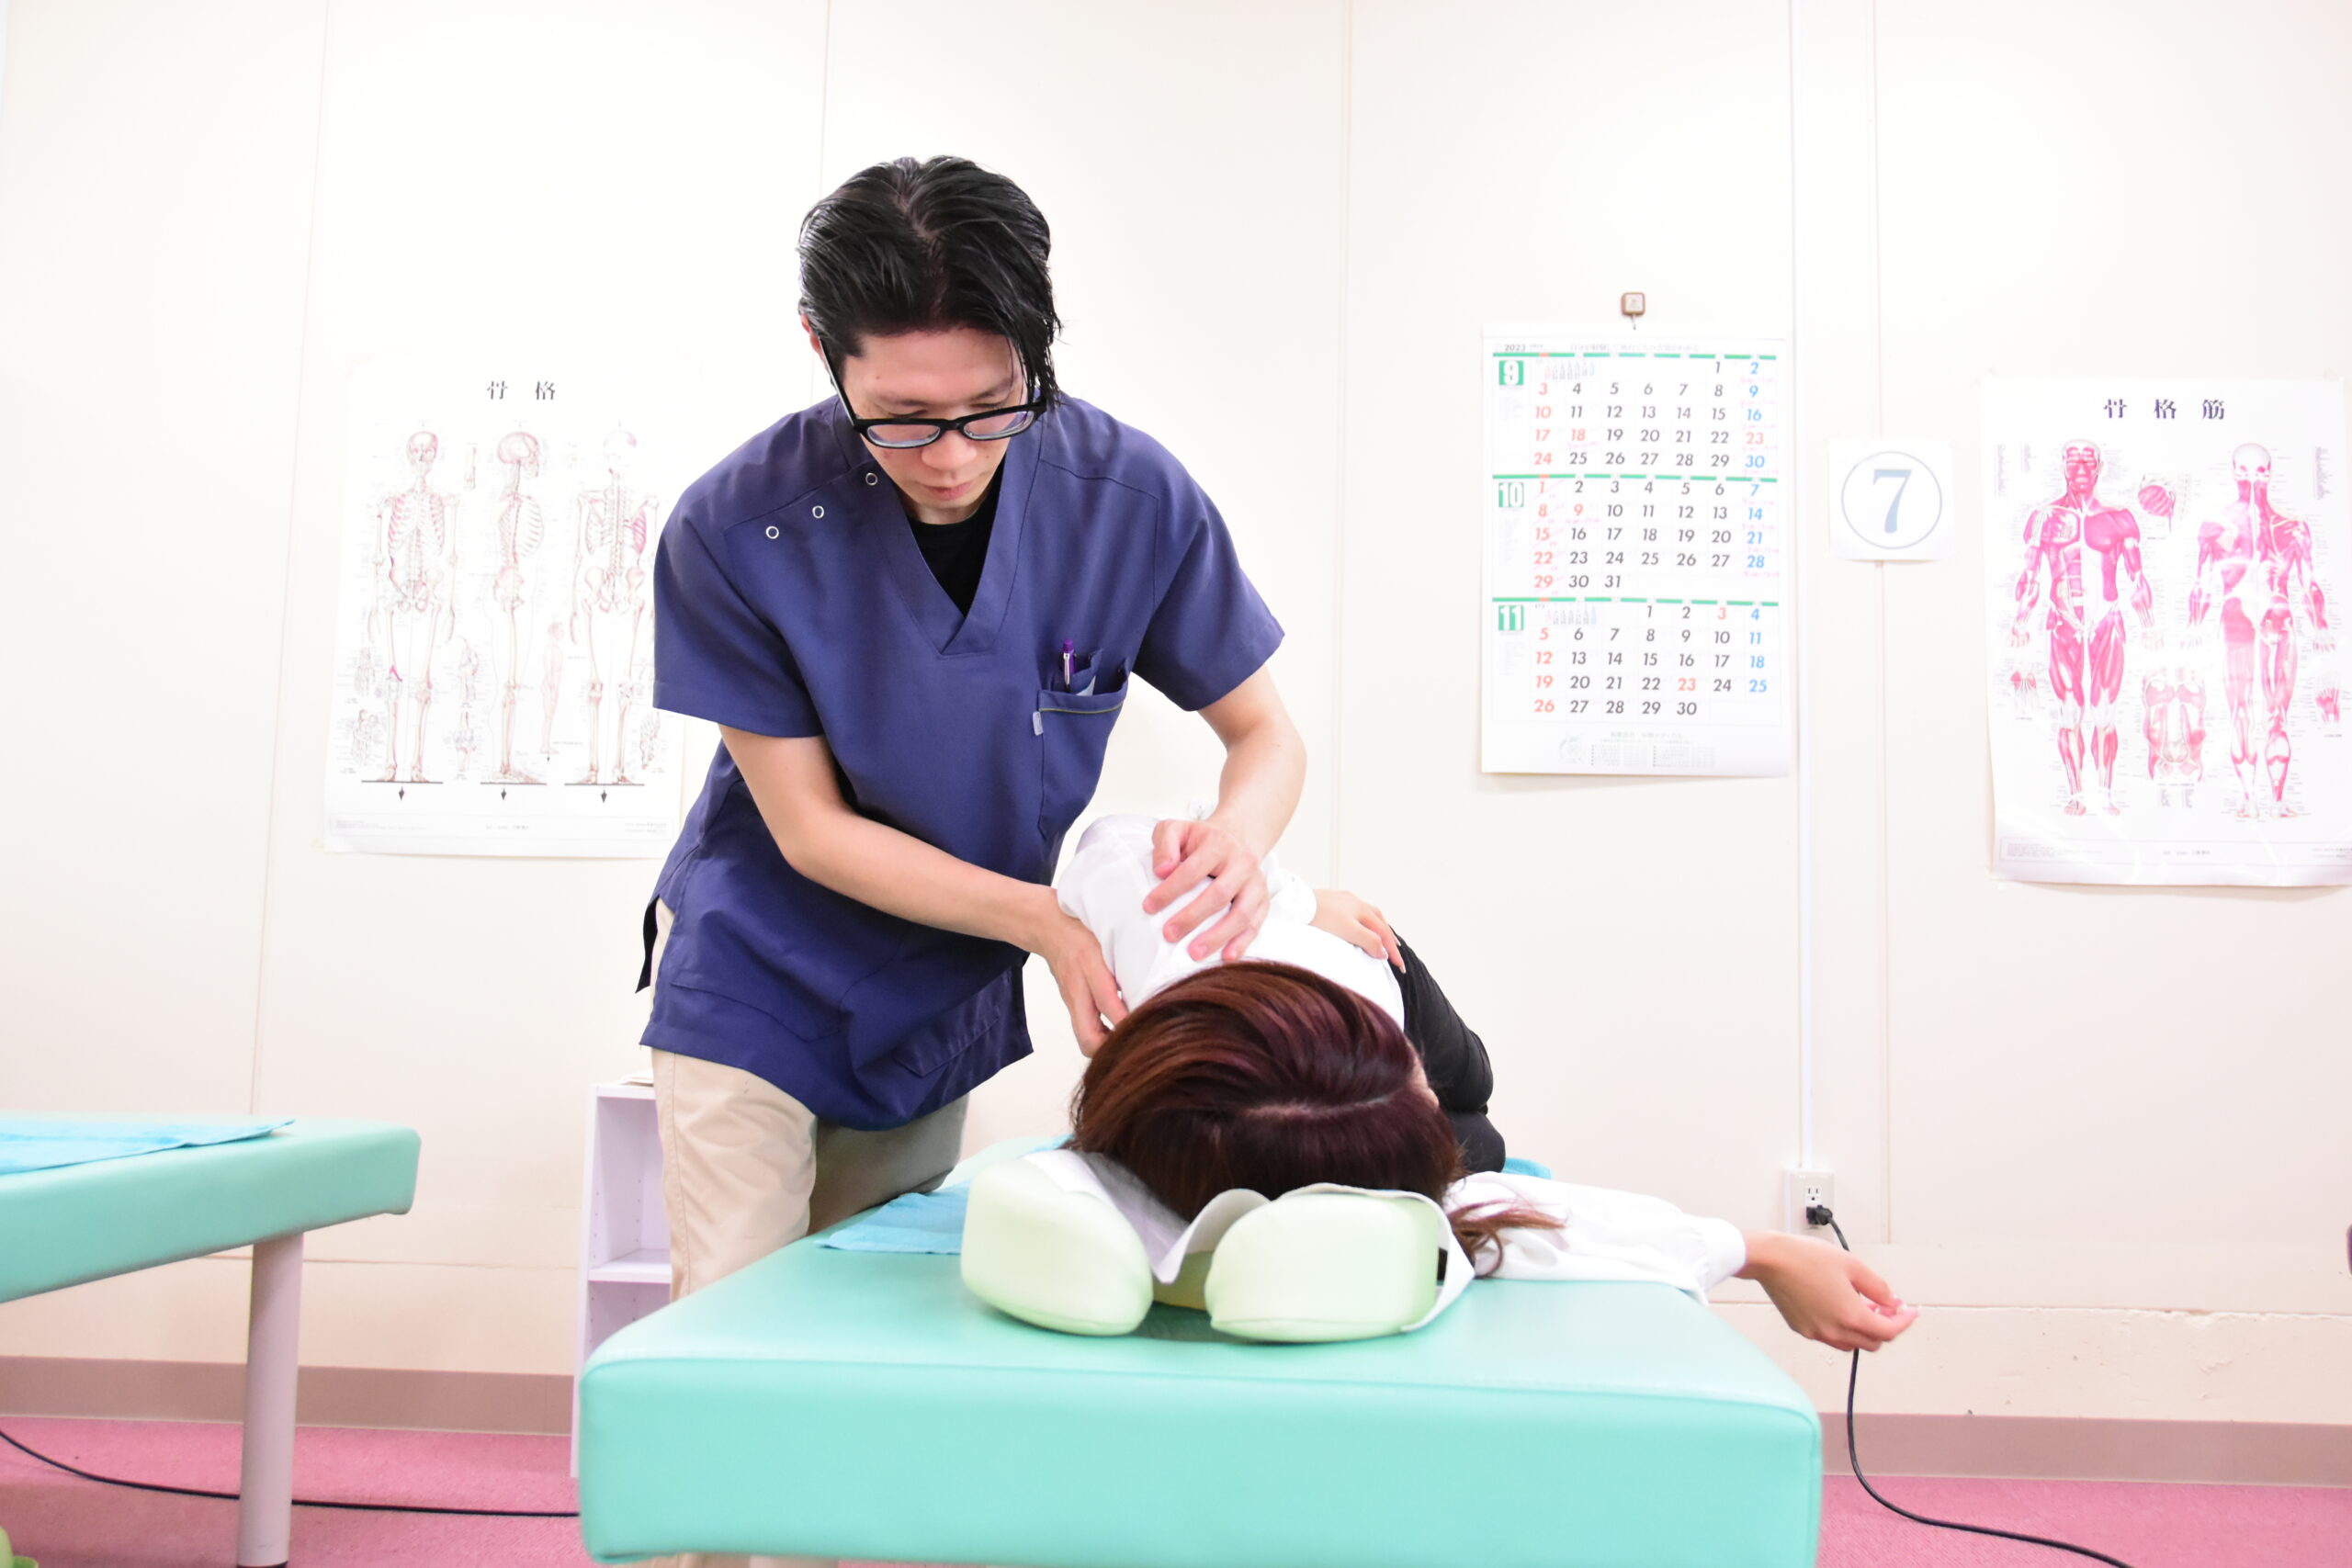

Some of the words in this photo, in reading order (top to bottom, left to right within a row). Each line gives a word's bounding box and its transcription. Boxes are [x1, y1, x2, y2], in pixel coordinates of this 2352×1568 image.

[1502, 360, 1521, 385] 9
[1715, 361, 1721, 374] 1
[1750, 361, 1760, 375] 2
[486, 380, 556, 400] 骨格
[1539, 382, 1548, 396] 3
[1572, 382, 1582, 395] 4
[1610, 382, 1619, 395] 5
[1644, 383, 1654, 396] 6
[1679, 383, 1689, 396] 7
[1713, 384, 1724, 398] 8
[1748, 385, 1759, 398] 9
[1535, 405, 1552, 419] 10
[1570, 405, 1583, 419] 11
[1607, 404, 1623, 419] 12
[1642, 405, 1657, 419] 13
[1677, 406, 1691, 420] 14
[1712, 407, 1726, 421] 15
[1747, 408, 1763, 422] 16
[2103, 399, 2224, 420] 骨格筋
[1535, 428, 1551, 442] 17
[1571, 428, 1586, 442] 18
[1607, 428, 1624, 442] 19
[1640, 428, 1660, 443] 20
[1675, 429, 1691, 444] 21
[1711, 430, 1729, 445] 22
[1747, 432, 1764, 445] 23
[1533, 452, 1553, 466] 24
[1569, 451, 1588, 465] 25
[1605, 451, 1625, 465] 26
[1640, 452, 1659, 466] 27
[1676, 453, 1694, 467] 28
[1711, 454, 1730, 468] 29
[1745, 455, 1766, 468] 30
[1499, 482, 1522, 507] 10
[1540, 480, 1545, 494] 1
[1574, 479, 1584, 493] 2
[1610, 479, 1620, 494] 3
[1644, 480, 1654, 494] 4
[1680, 481, 1690, 495] 5
[1714, 482, 1725, 496] 6
[1750, 483, 1760, 497] 7
[1872, 468, 1913, 534] 7
[1538, 503, 1548, 518] 8
[1573, 503, 1584, 516] 9
[1607, 503, 1623, 518] 10
[1642, 504, 1655, 518] 11
[1679, 505, 1694, 519] 12
[1713, 506, 1728, 520] 13
[1748, 506, 1763, 521] 14
[1535, 527, 1551, 541] 15
[1571, 527, 1587, 541] 16
[1607, 527, 1623, 541] 17
[1643, 527, 1658, 542] 18
[1678, 528, 1695, 543] 19
[1712, 529, 1732, 544] 20
[1747, 530, 1763, 545] 21
[1533, 550, 1554, 565] 22
[1569, 550, 1589, 565] 23
[1605, 550, 1624, 565] 24
[1641, 551, 1659, 566] 25
[1676, 552, 1697, 567] 26
[1712, 553, 1731, 568] 27
[1747, 554, 1765, 570] 28
[1533, 574, 1554, 589] 29
[1567, 574, 1589, 589] 30
[1604, 574, 1622, 589] 31
[1499, 605, 1522, 631] 11
[1647, 604, 1653, 618] 1
[1681, 605, 1691, 619] 2
[1717, 606, 1726, 620] 3
[1750, 607, 1760, 621] 4
[1539, 626, 1549, 641] 5
[1573, 626, 1584, 641] 6
[1610, 627, 1621, 641] 7
[1645, 627, 1656, 642] 8
[1680, 628, 1691, 643] 9
[1714, 630, 1731, 645] 10
[1749, 631, 1762, 645] 11
[1536, 650, 1554, 665] 12
[1571, 650, 1587, 665] 13
[1607, 651, 1623, 666] 14
[1643, 652, 1658, 667] 15
[1679, 653, 1695, 668] 16
[1714, 654, 1731, 668] 17
[1750, 655, 1765, 670] 18
[1536, 675, 1555, 689] 19
[1569, 675, 1591, 690] 20
[1605, 675, 1623, 690] 21
[1641, 676, 1661, 691] 22
[1678, 677, 1697, 692] 23
[1713, 678, 1732, 693] 24
[1748, 678, 1768, 694] 25
[1533, 699, 1555, 714] 26
[1569, 699, 1589, 714] 27
[1605, 699, 1625, 715] 28
[1641, 700, 1662, 715] 29
[1676, 701, 1698, 716] 30
